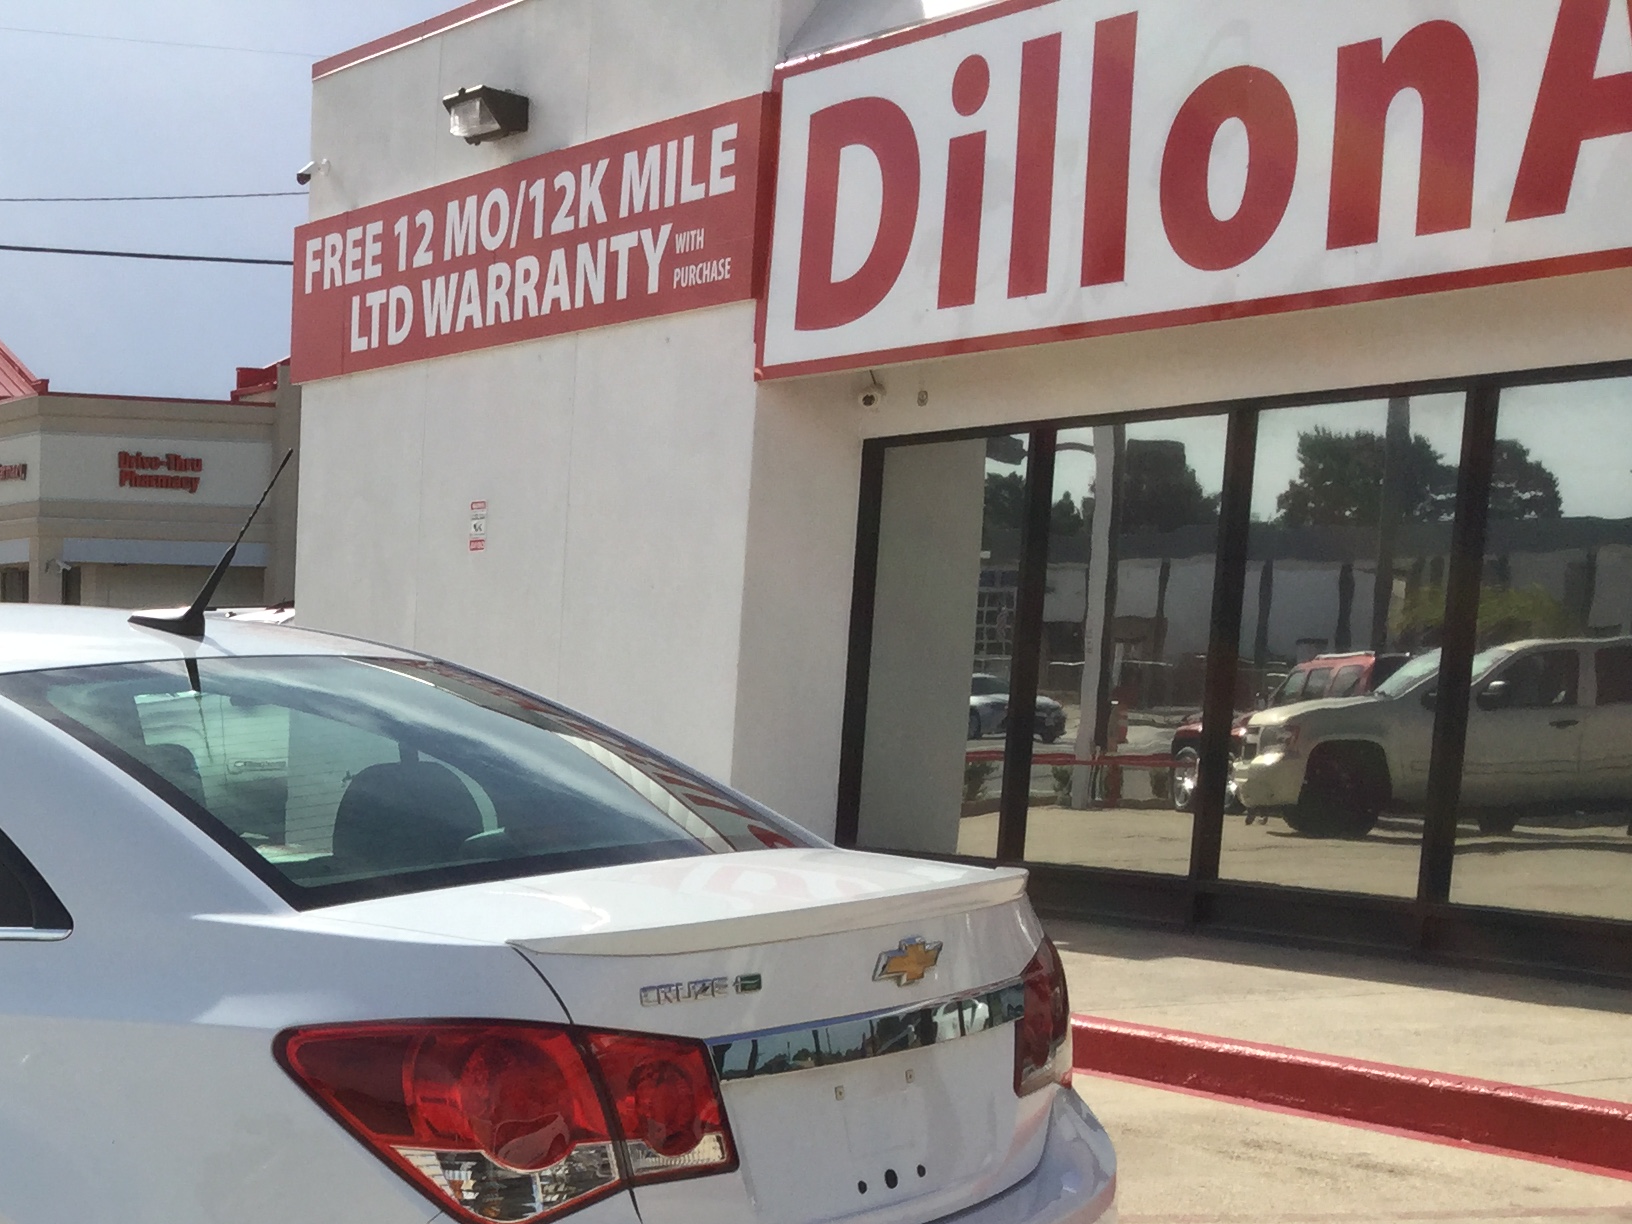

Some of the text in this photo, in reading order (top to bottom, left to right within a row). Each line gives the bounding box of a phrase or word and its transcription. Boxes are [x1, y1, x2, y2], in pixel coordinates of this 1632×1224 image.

[305, 122, 738, 294] FREE 12 MO/12K MILE
[675, 228, 705, 254] WITH
[350, 223, 673, 353] LTD WARRANTY
[673, 257, 732, 289] PURCHASE
[119, 469, 200, 494] Pharmacy
[639, 976, 729, 1007] CRUZE
